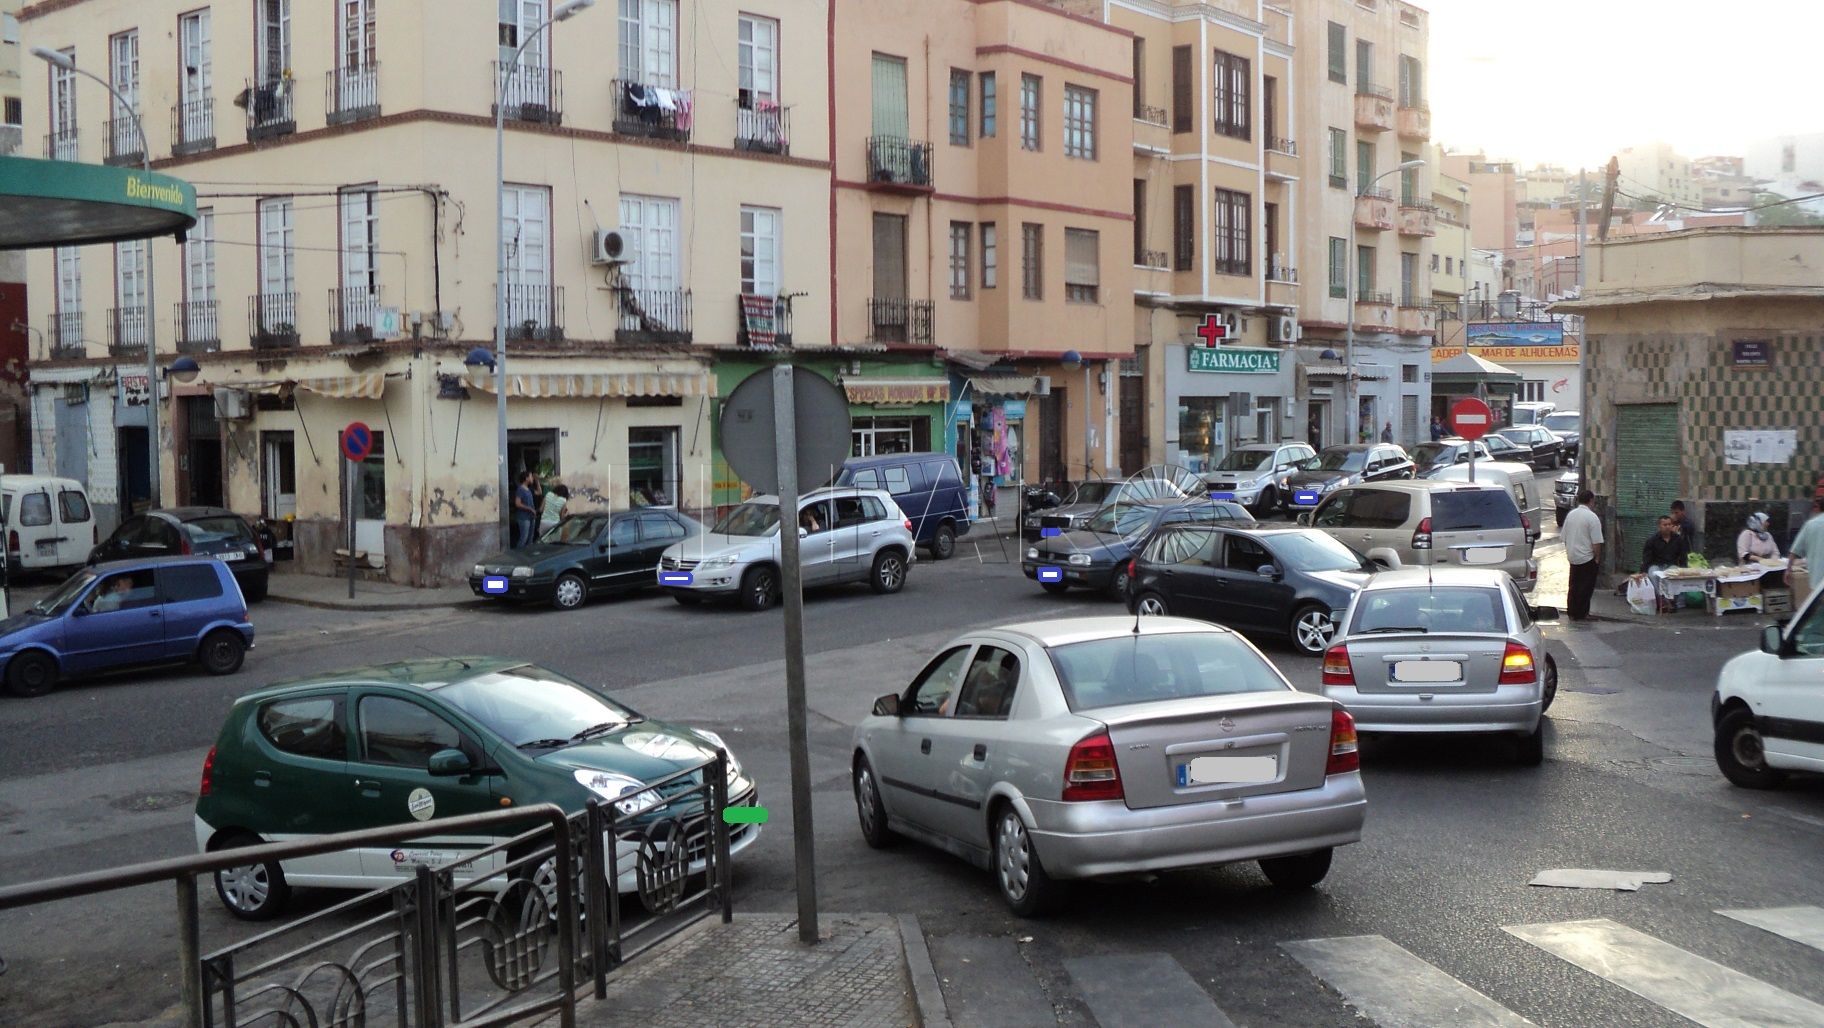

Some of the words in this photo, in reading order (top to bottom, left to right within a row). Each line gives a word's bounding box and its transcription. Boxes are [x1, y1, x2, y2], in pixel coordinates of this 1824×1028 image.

[126, 175, 183, 206] Bienvenido
[1202, 352, 1271, 368] FARMACIA
[1480, 348, 1502, 357] MAR
[1505, 348, 1516, 357] DE
[1520, 347, 1578, 357] ALHUCEMAS
